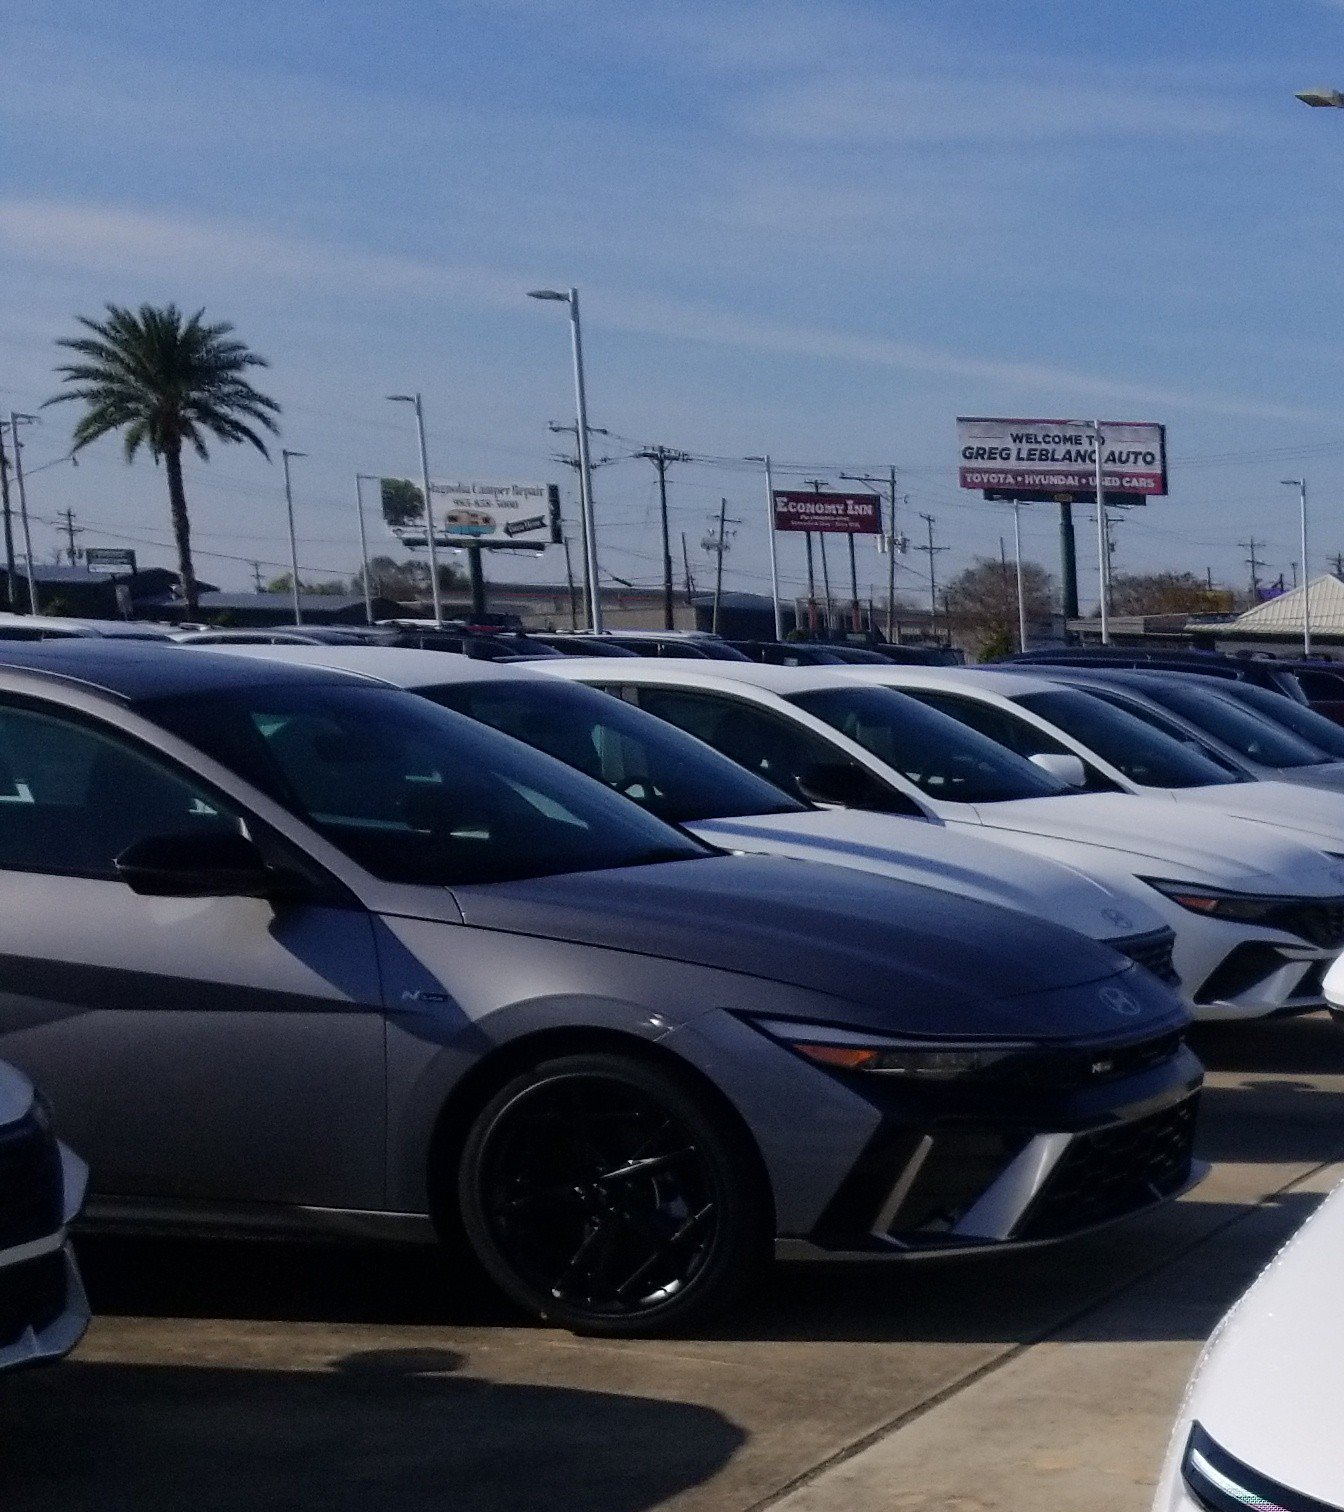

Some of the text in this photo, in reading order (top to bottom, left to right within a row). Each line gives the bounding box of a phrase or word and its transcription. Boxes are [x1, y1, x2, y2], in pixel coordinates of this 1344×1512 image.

[1009, 433, 1083, 446] WELCOME
[961, 446, 1011, 461] GREG
[1103, 449, 1155, 465] AUTO
[965, 472, 1155, 488] TOYOTA HYUNDAI UED CARS
[512, 484, 545, 500] Repair
[775, 496, 845, 515] ECONOMY
